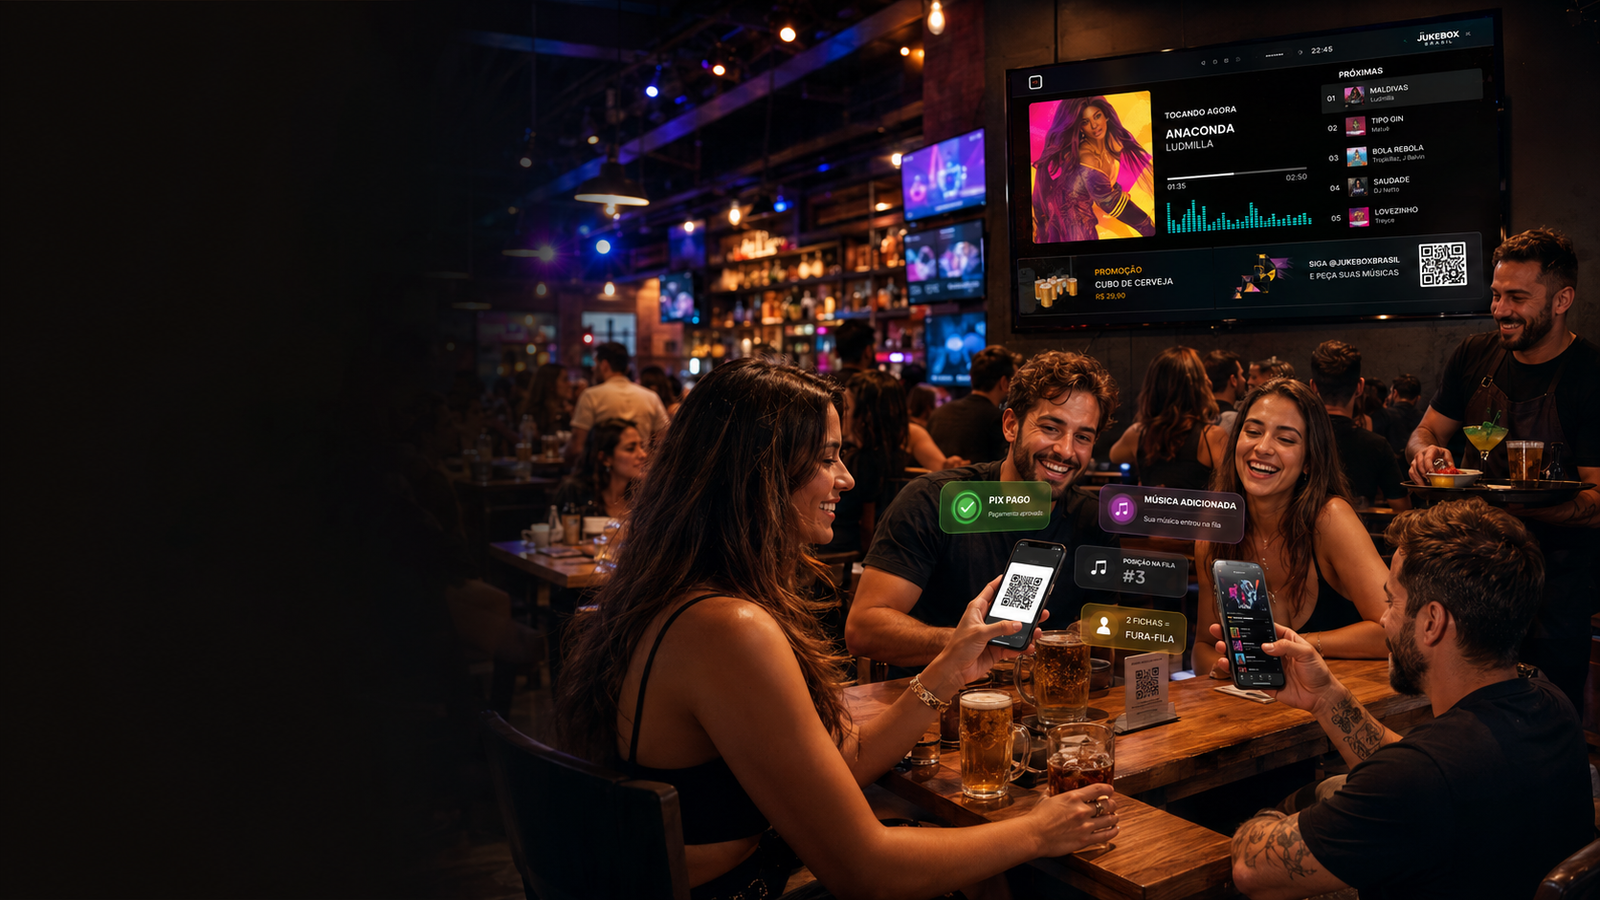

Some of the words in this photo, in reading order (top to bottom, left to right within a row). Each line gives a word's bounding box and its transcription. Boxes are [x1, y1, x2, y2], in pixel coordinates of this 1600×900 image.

[1417, 30, 1460, 42] JUKEBOX
[1311, 45, 1333, 54] 22:45
[1338, 67, 1384, 78] PRÓXIMAS
[1369, 84, 1409, 94] MALDIVAS
[1164, 108, 1206, 119] TOCANDO
[1207, 105, 1237, 115] AGORA
[1165, 123, 1235, 139] ANACONDA
[1327, 124, 1338, 132] 02
[1165, 139, 1214, 152] LUDMILLA
[1372, 147, 1393, 155] BOLA
[1394, 144, 1425, 153] REBOLA
[1328, 154, 1339, 162] 03
[1167, 182, 1187, 190] 01:35
[1285, 173, 1308, 181] 02:50
[1373, 176, 1410, 186] SAUDADE
[1374, 206, 1419, 216] LOVEZINHO
[1308, 260, 1328, 268] SIGA
[1328, 256, 1400, 268] @JUKEBOXBRASIL
[1094, 265, 1142, 276] PROMOÇÃO
[1309, 272, 1315, 280] E
[1316, 271, 1337, 281] PEÇA
[1338, 271, 1361, 279] SUAS
[1362, 268, 1400, 278] MÚSICAS
[1095, 280, 1119, 289] CUBO
[1121, 279, 1133, 288] DE
[1134, 277, 1174, 287] CERVEJA
